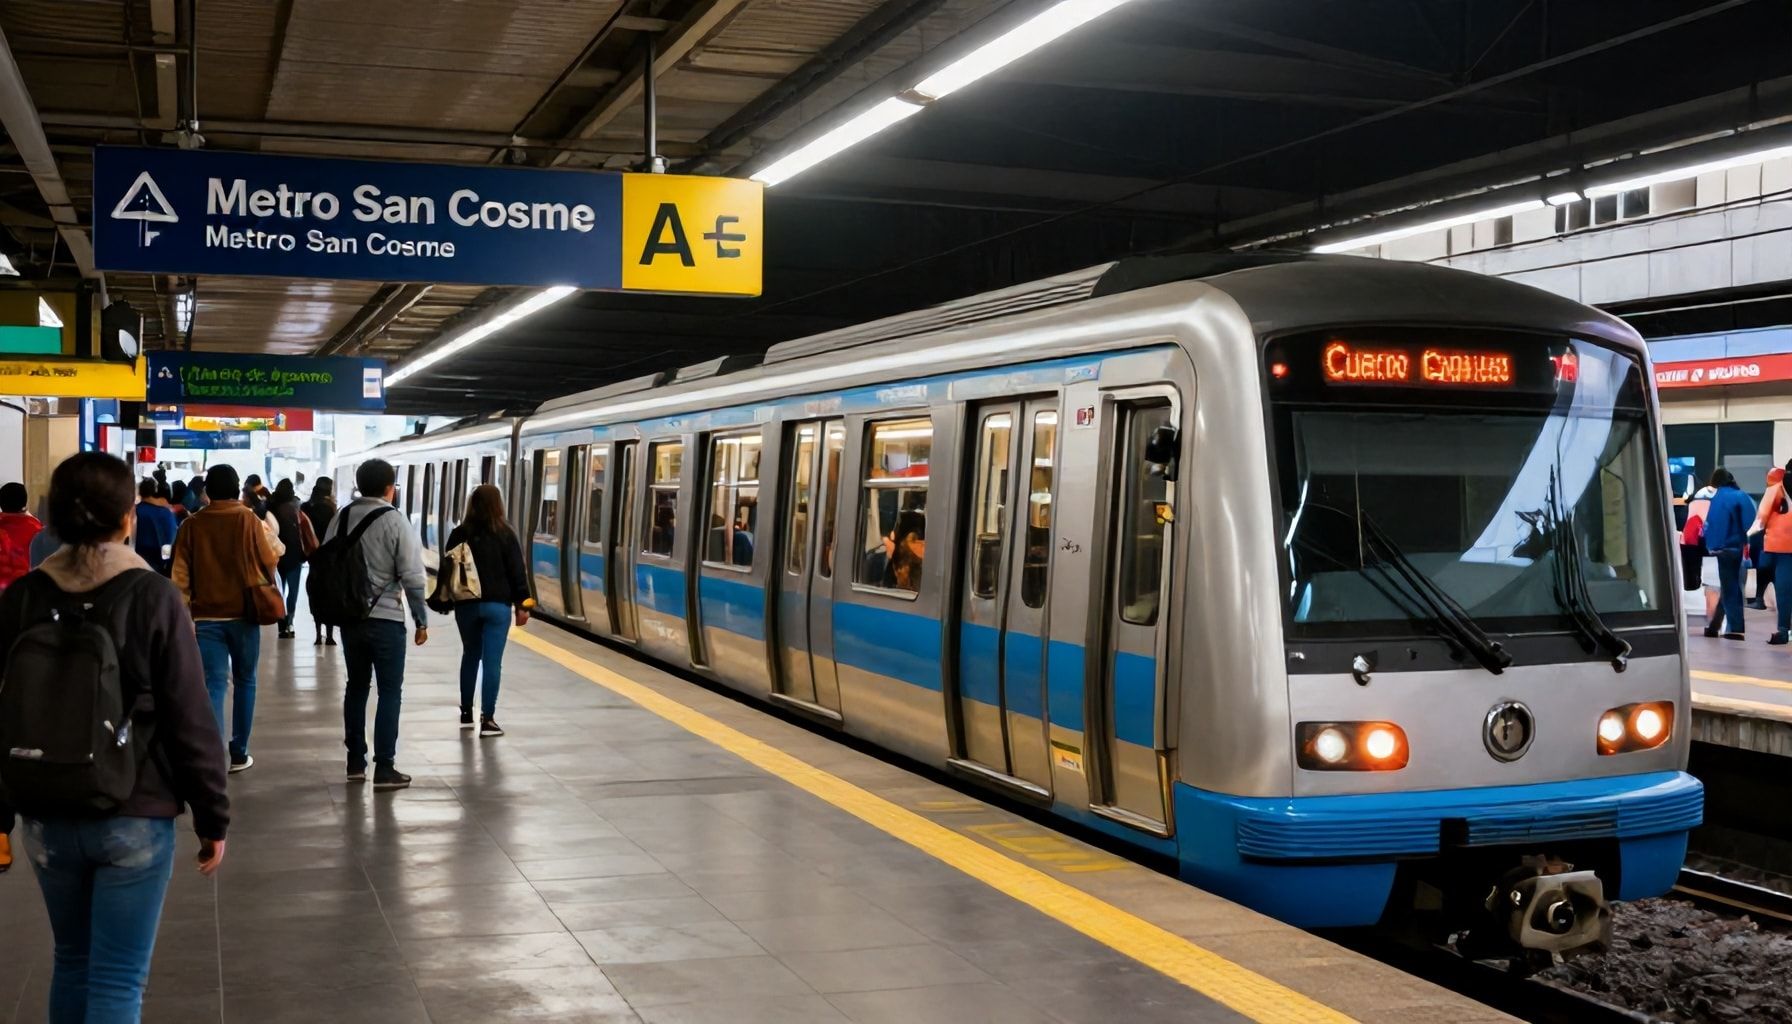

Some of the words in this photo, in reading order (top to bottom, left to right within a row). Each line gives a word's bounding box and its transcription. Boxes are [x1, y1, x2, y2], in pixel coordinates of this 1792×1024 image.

[206, 178, 340, 221] Metro
[352, 184, 435, 226] San
[448, 189, 597, 234] Cosme
[306, 229, 358, 255] San
[366, 232, 456, 258] Cosme
[639, 202, 696, 267] A
